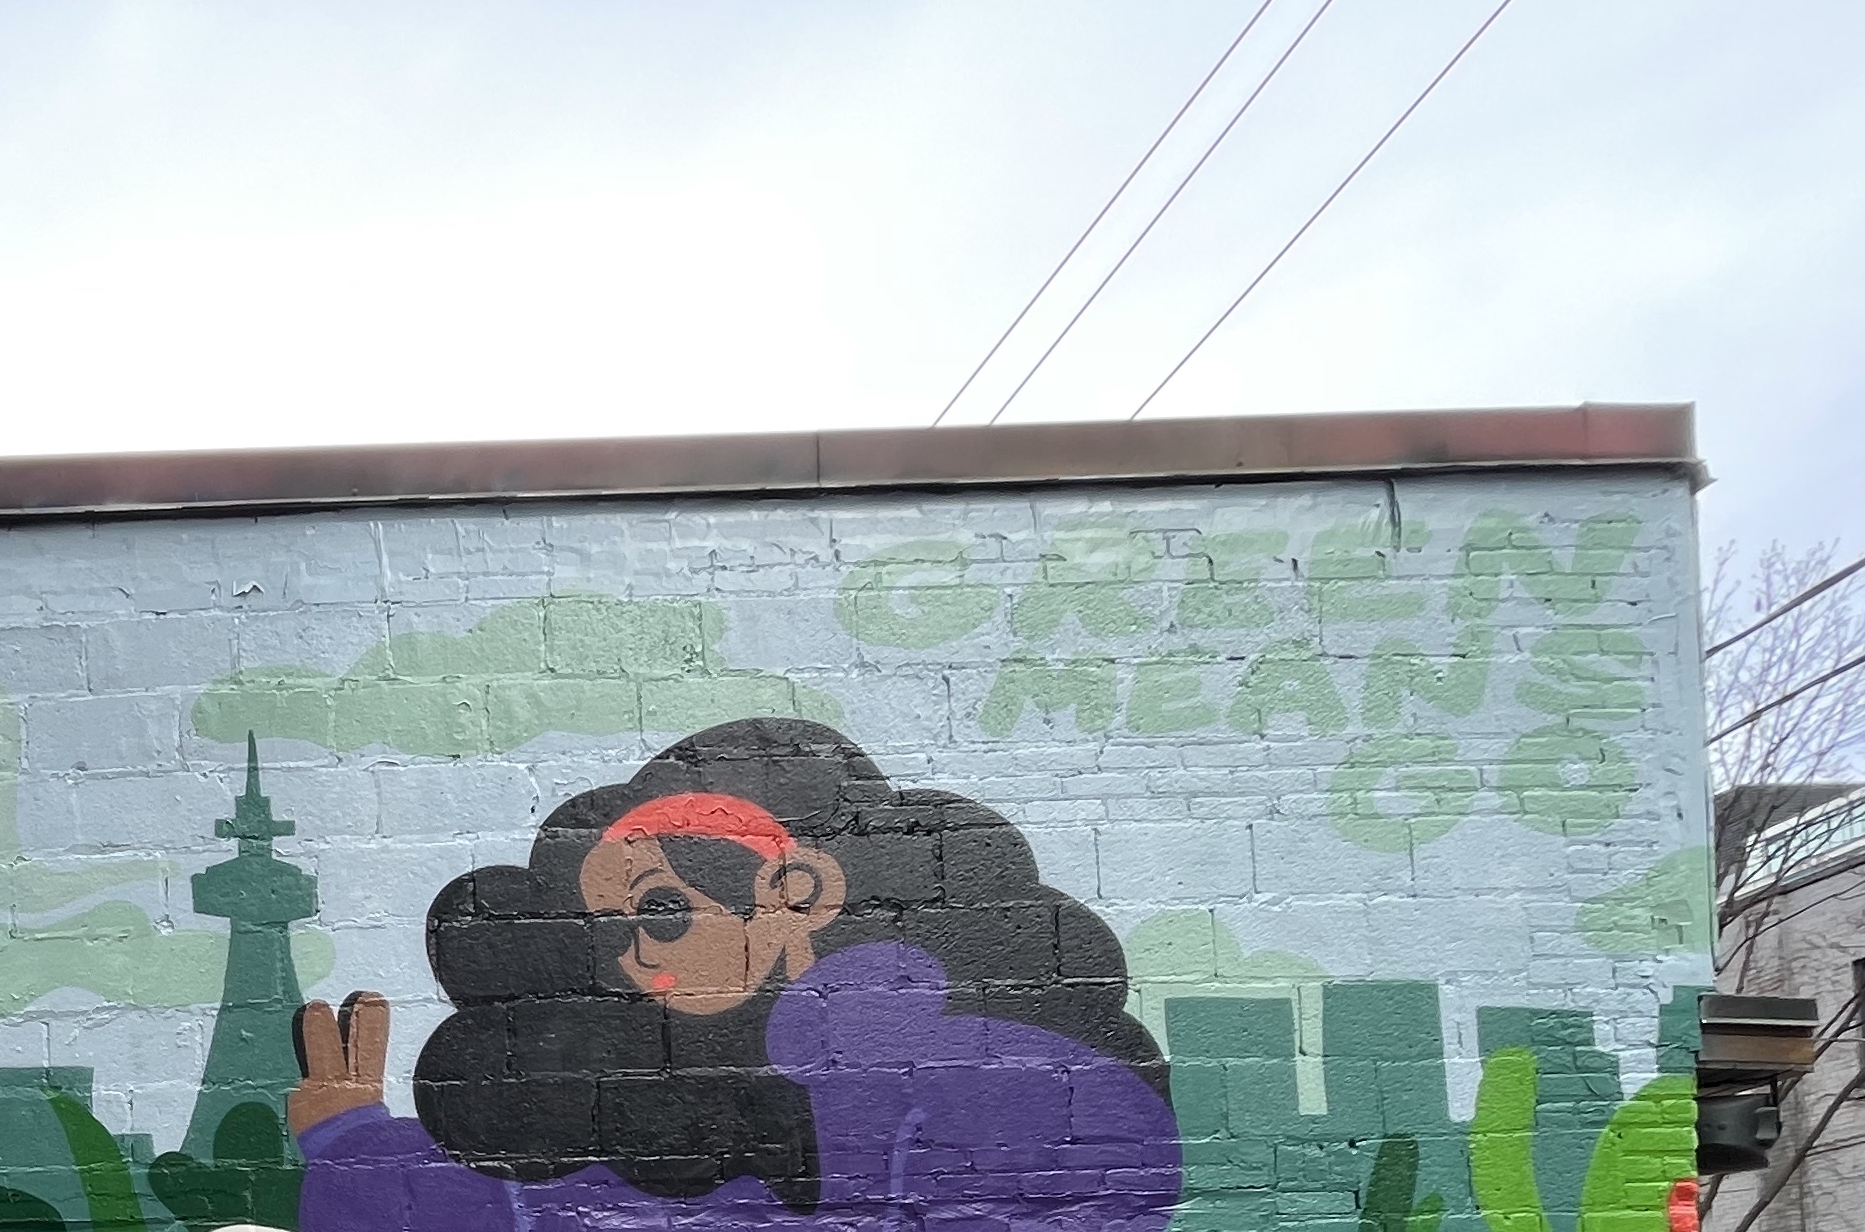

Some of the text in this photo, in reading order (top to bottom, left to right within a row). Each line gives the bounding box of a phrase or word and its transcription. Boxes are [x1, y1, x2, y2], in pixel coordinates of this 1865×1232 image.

[836, 508, 1645, 650] GREEN
[975, 626, 1647, 739] MEANS
[1331, 725, 1638, 854] GO
